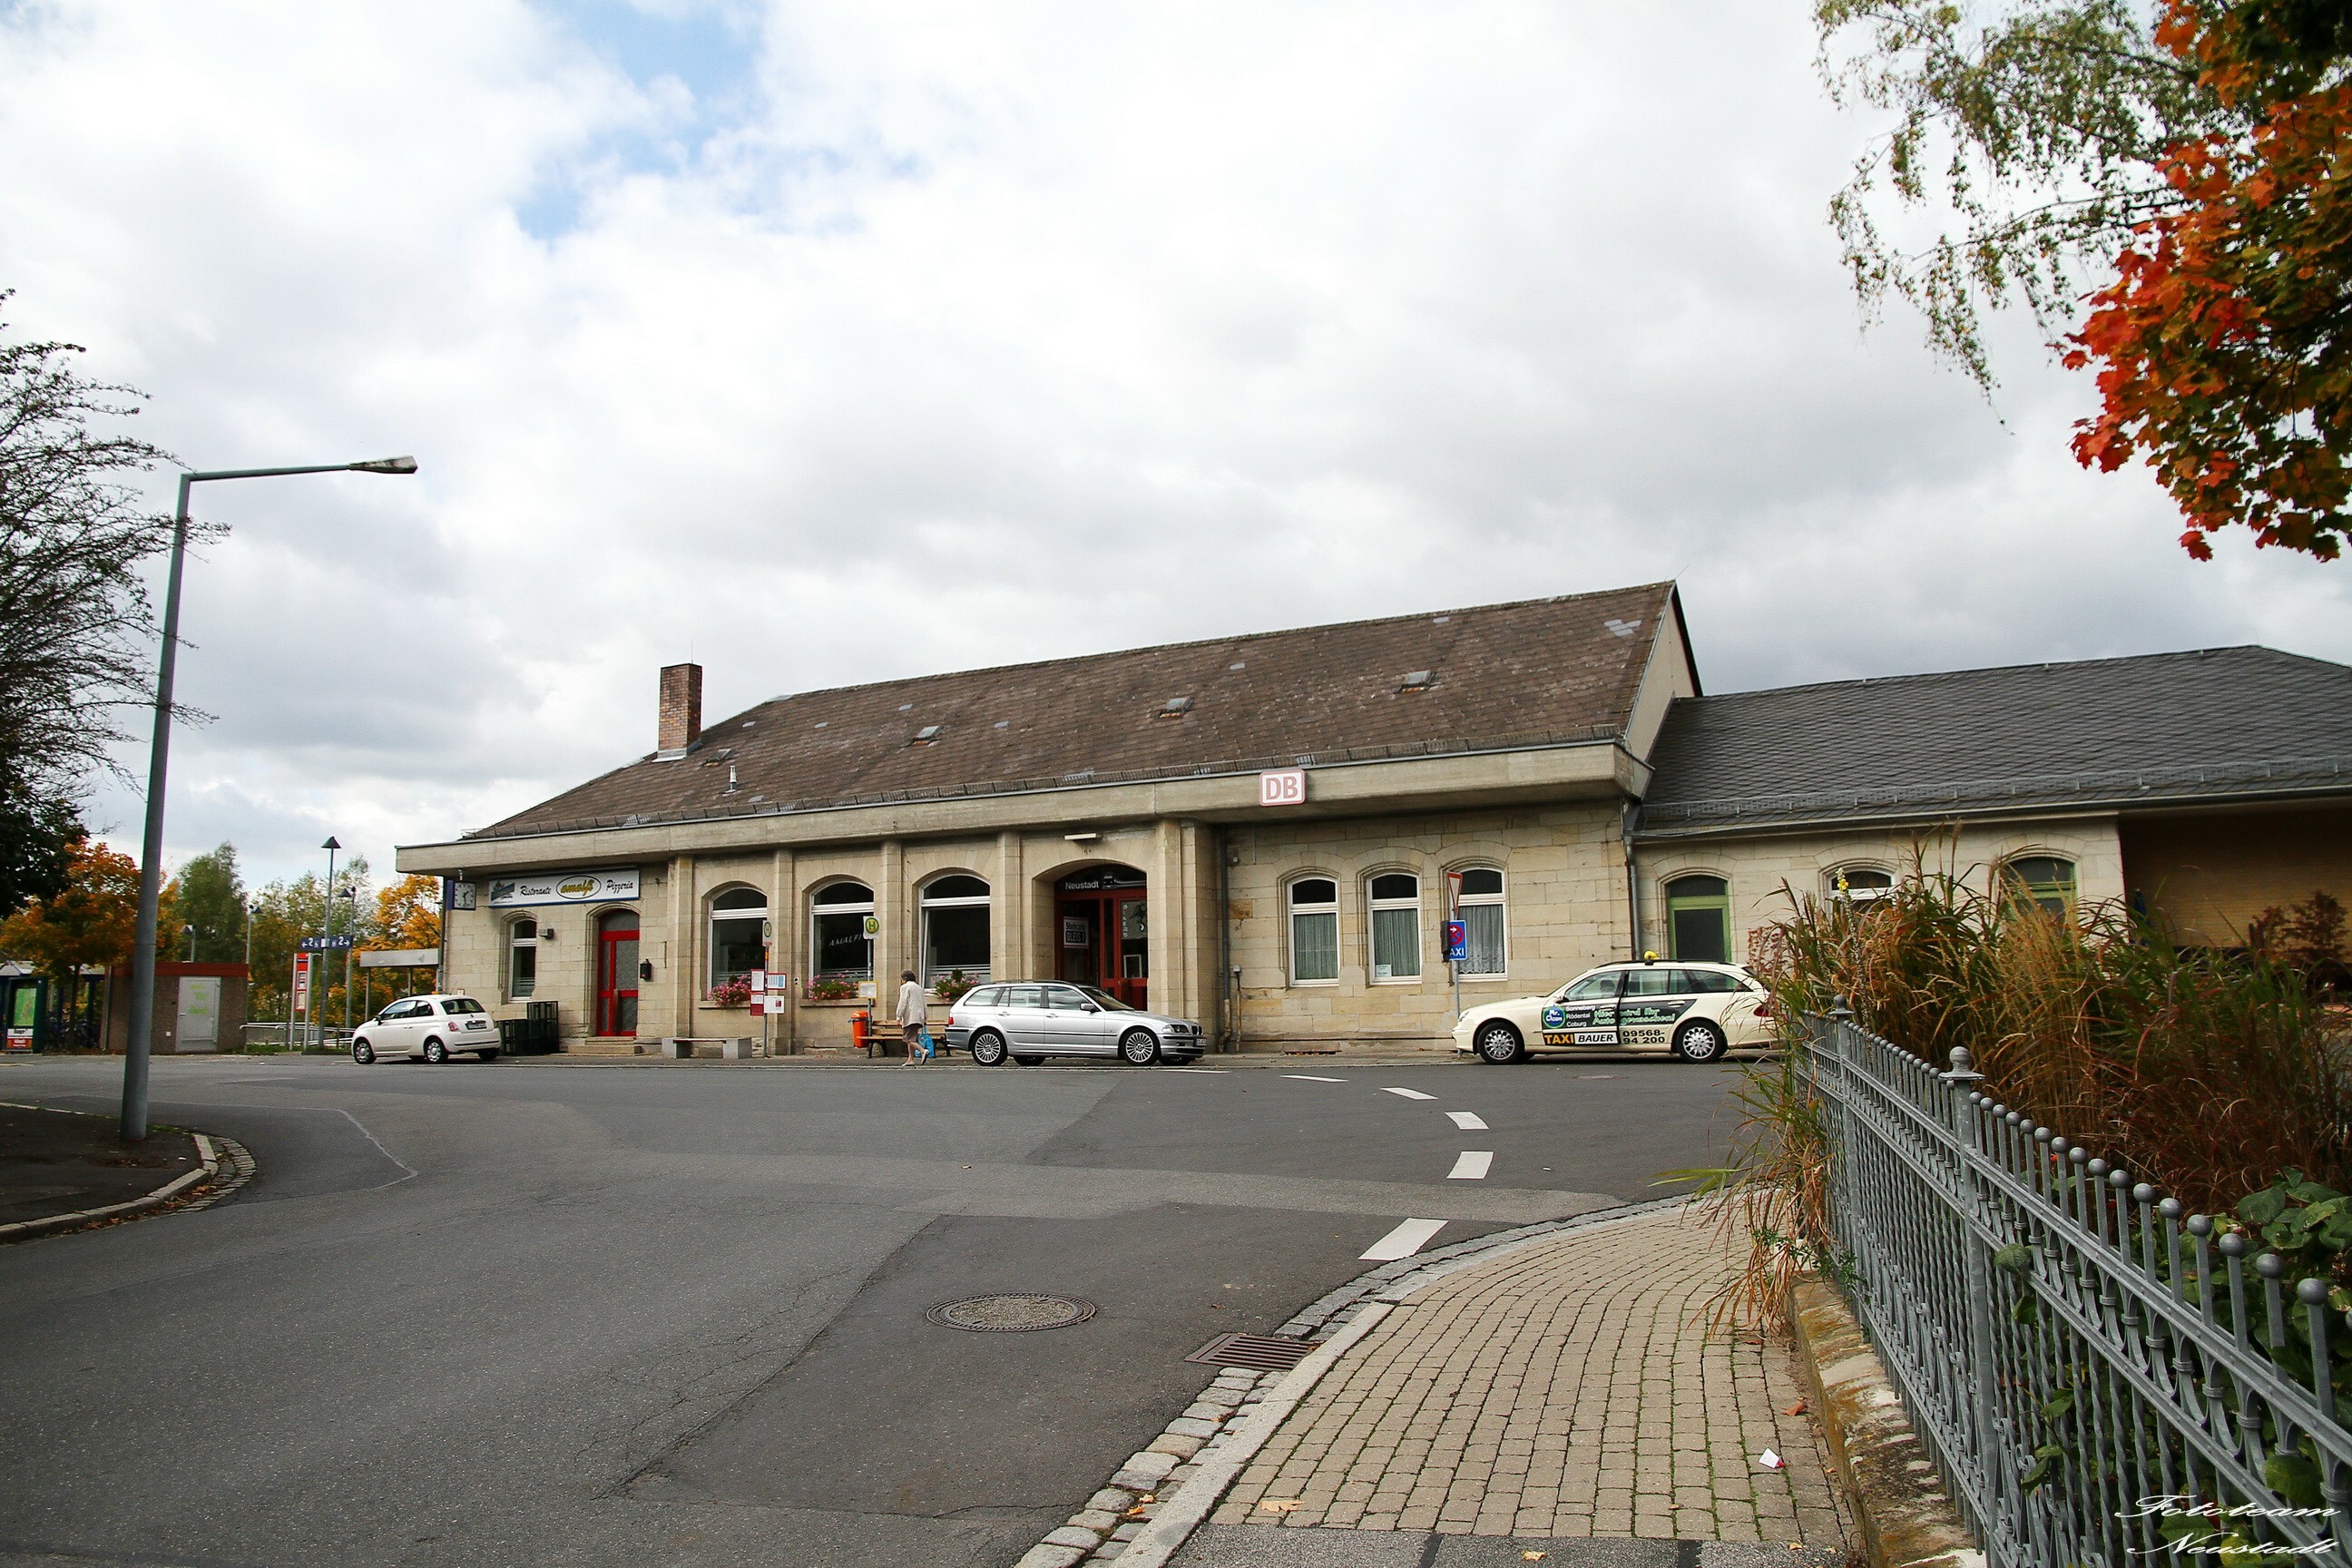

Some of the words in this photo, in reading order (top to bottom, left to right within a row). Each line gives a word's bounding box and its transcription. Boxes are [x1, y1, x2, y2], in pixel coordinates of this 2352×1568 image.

[1266, 776, 1298, 800] DB
[519, 885, 552, 897] Ristorante
[560, 878, 594, 897] amalfi
[605, 878, 633, 894] Pizzeria
[1065, 881, 1099, 889] Neustadt
[868, 920, 877, 931] H
[308, 936, 314, 946] 2
[338, 936, 344, 946] 2
[828, 933, 863, 946] AMALFI
[1450, 947, 1465, 956] AXI
[1592, 1017, 1616, 1025] Auto
[1622, 1029, 1665, 1037] 09568-
[1544, 1034, 1574, 1044] TAXI
[1578, 1034, 1614, 1043] BAUER
[1622, 1036, 1639, 1044] 94
